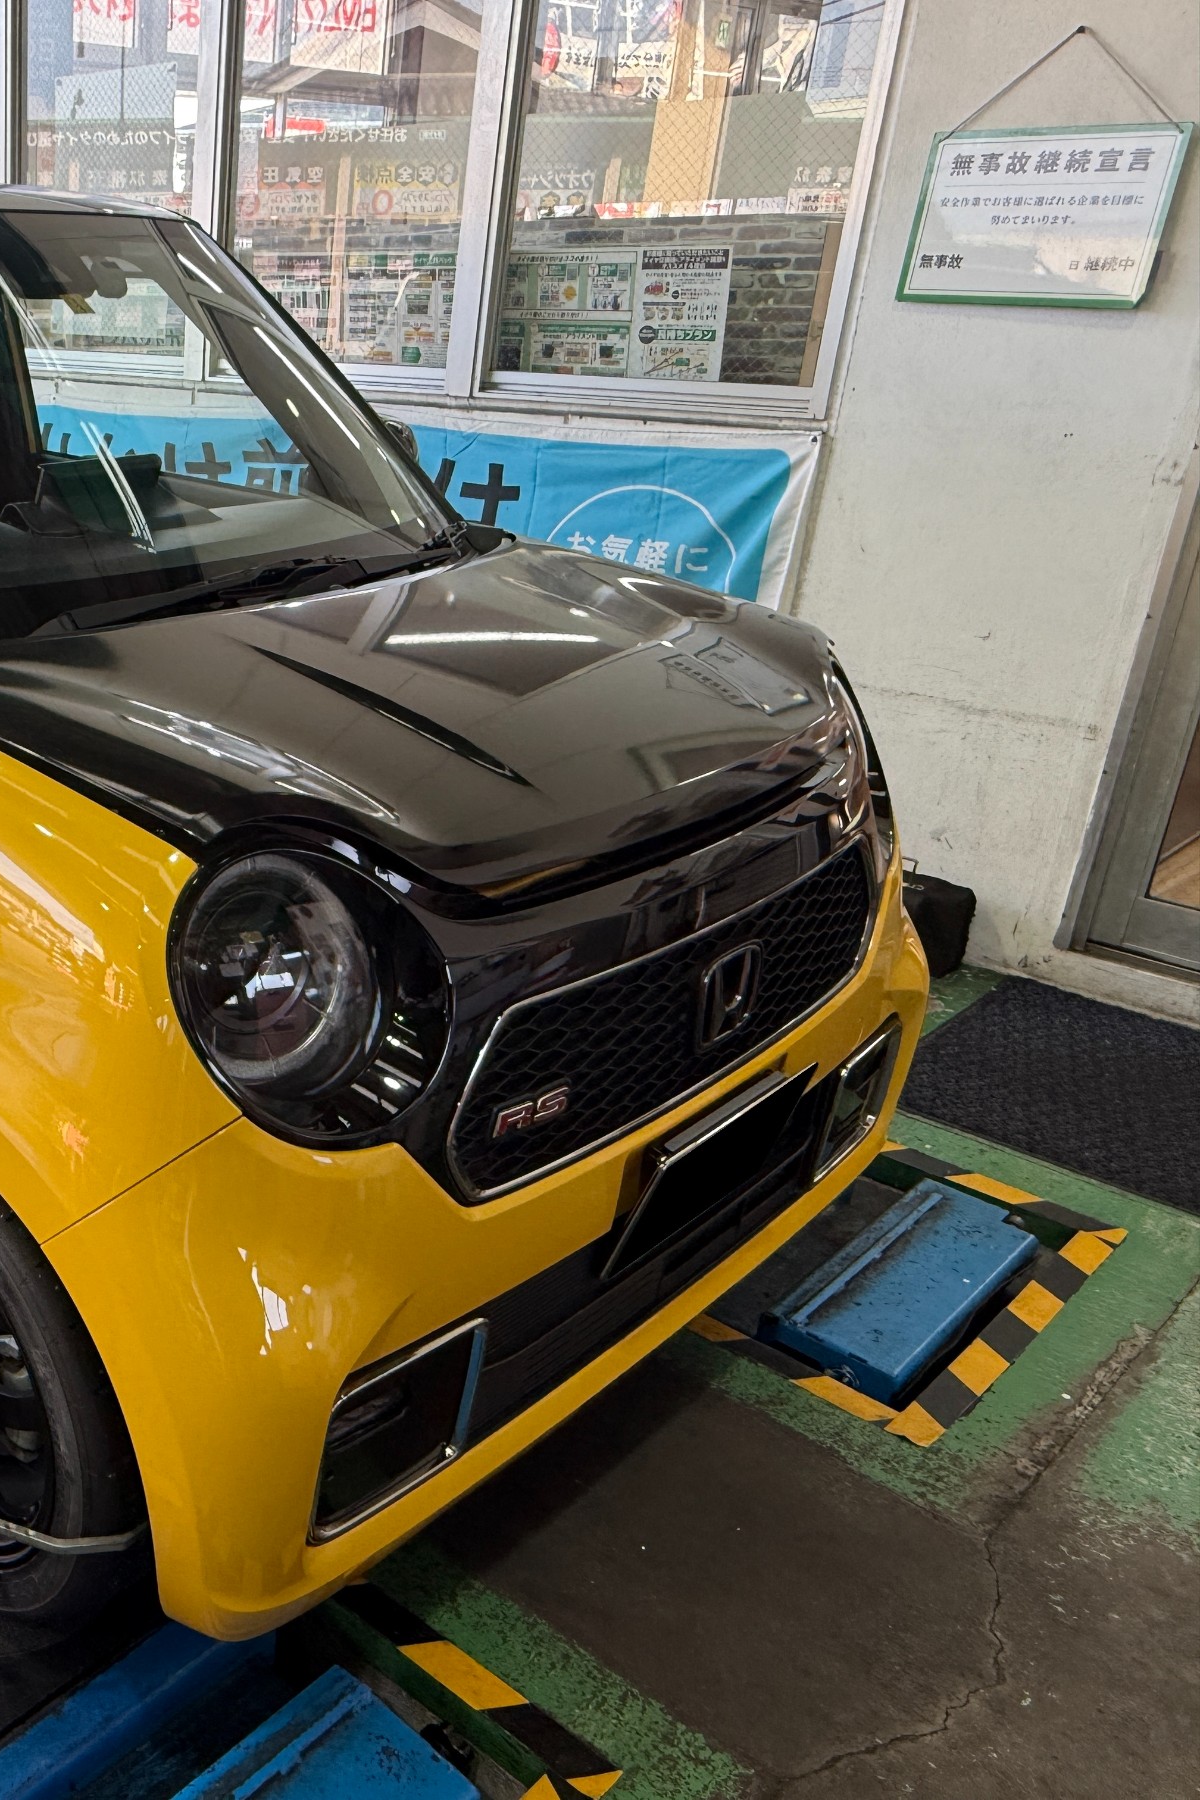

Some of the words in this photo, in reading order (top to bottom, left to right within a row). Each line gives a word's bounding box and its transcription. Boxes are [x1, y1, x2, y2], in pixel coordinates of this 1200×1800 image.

[950, 147, 1156, 177] 無事故継続宣言
[990, 213, 1076, 226] 努めてまいります。
[918, 253, 964, 269] 無事故
[1083, 255, 1136, 272] 継続中
[566, 530, 709, 575] お気軽に
[492, 1086, 570, 1138] RS
